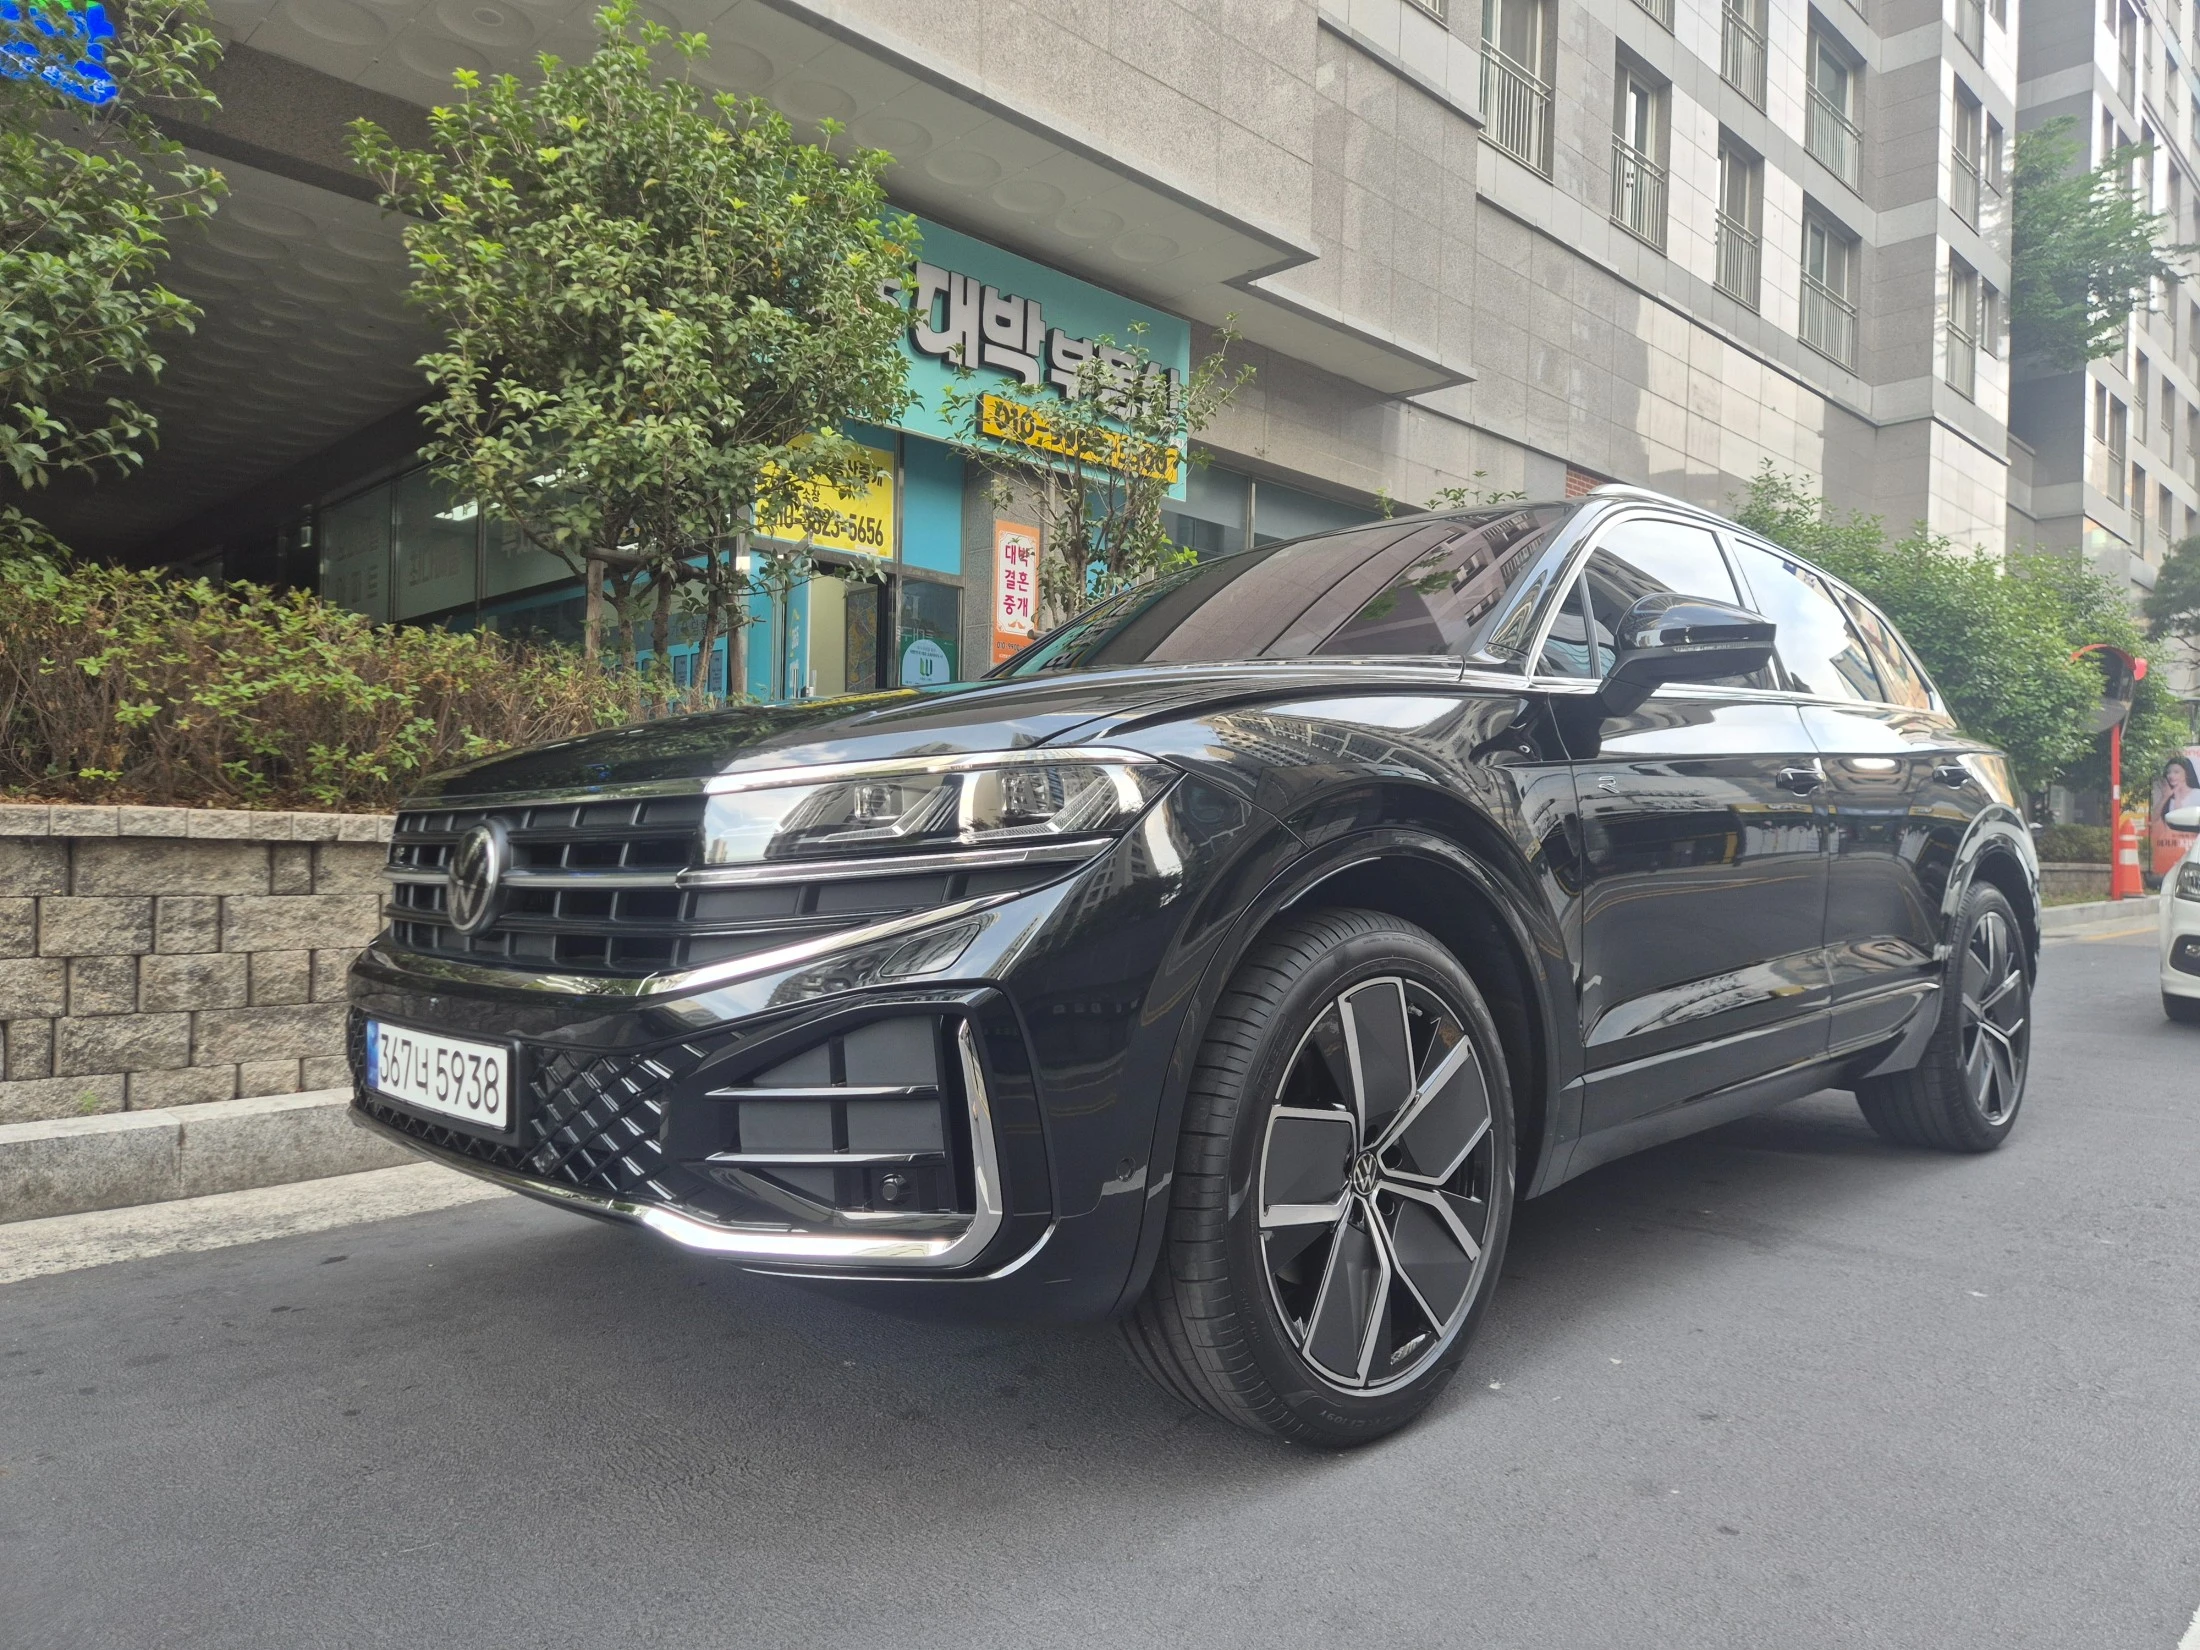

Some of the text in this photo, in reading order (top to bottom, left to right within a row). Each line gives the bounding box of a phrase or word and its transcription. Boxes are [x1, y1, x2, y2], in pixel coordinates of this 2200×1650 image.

[1004, 544, 1029, 567] 대박
[1004, 569, 1030, 592] 결혼
[1003, 594, 1029, 618] 중개
[436, 1047, 499, 1115] 5938
